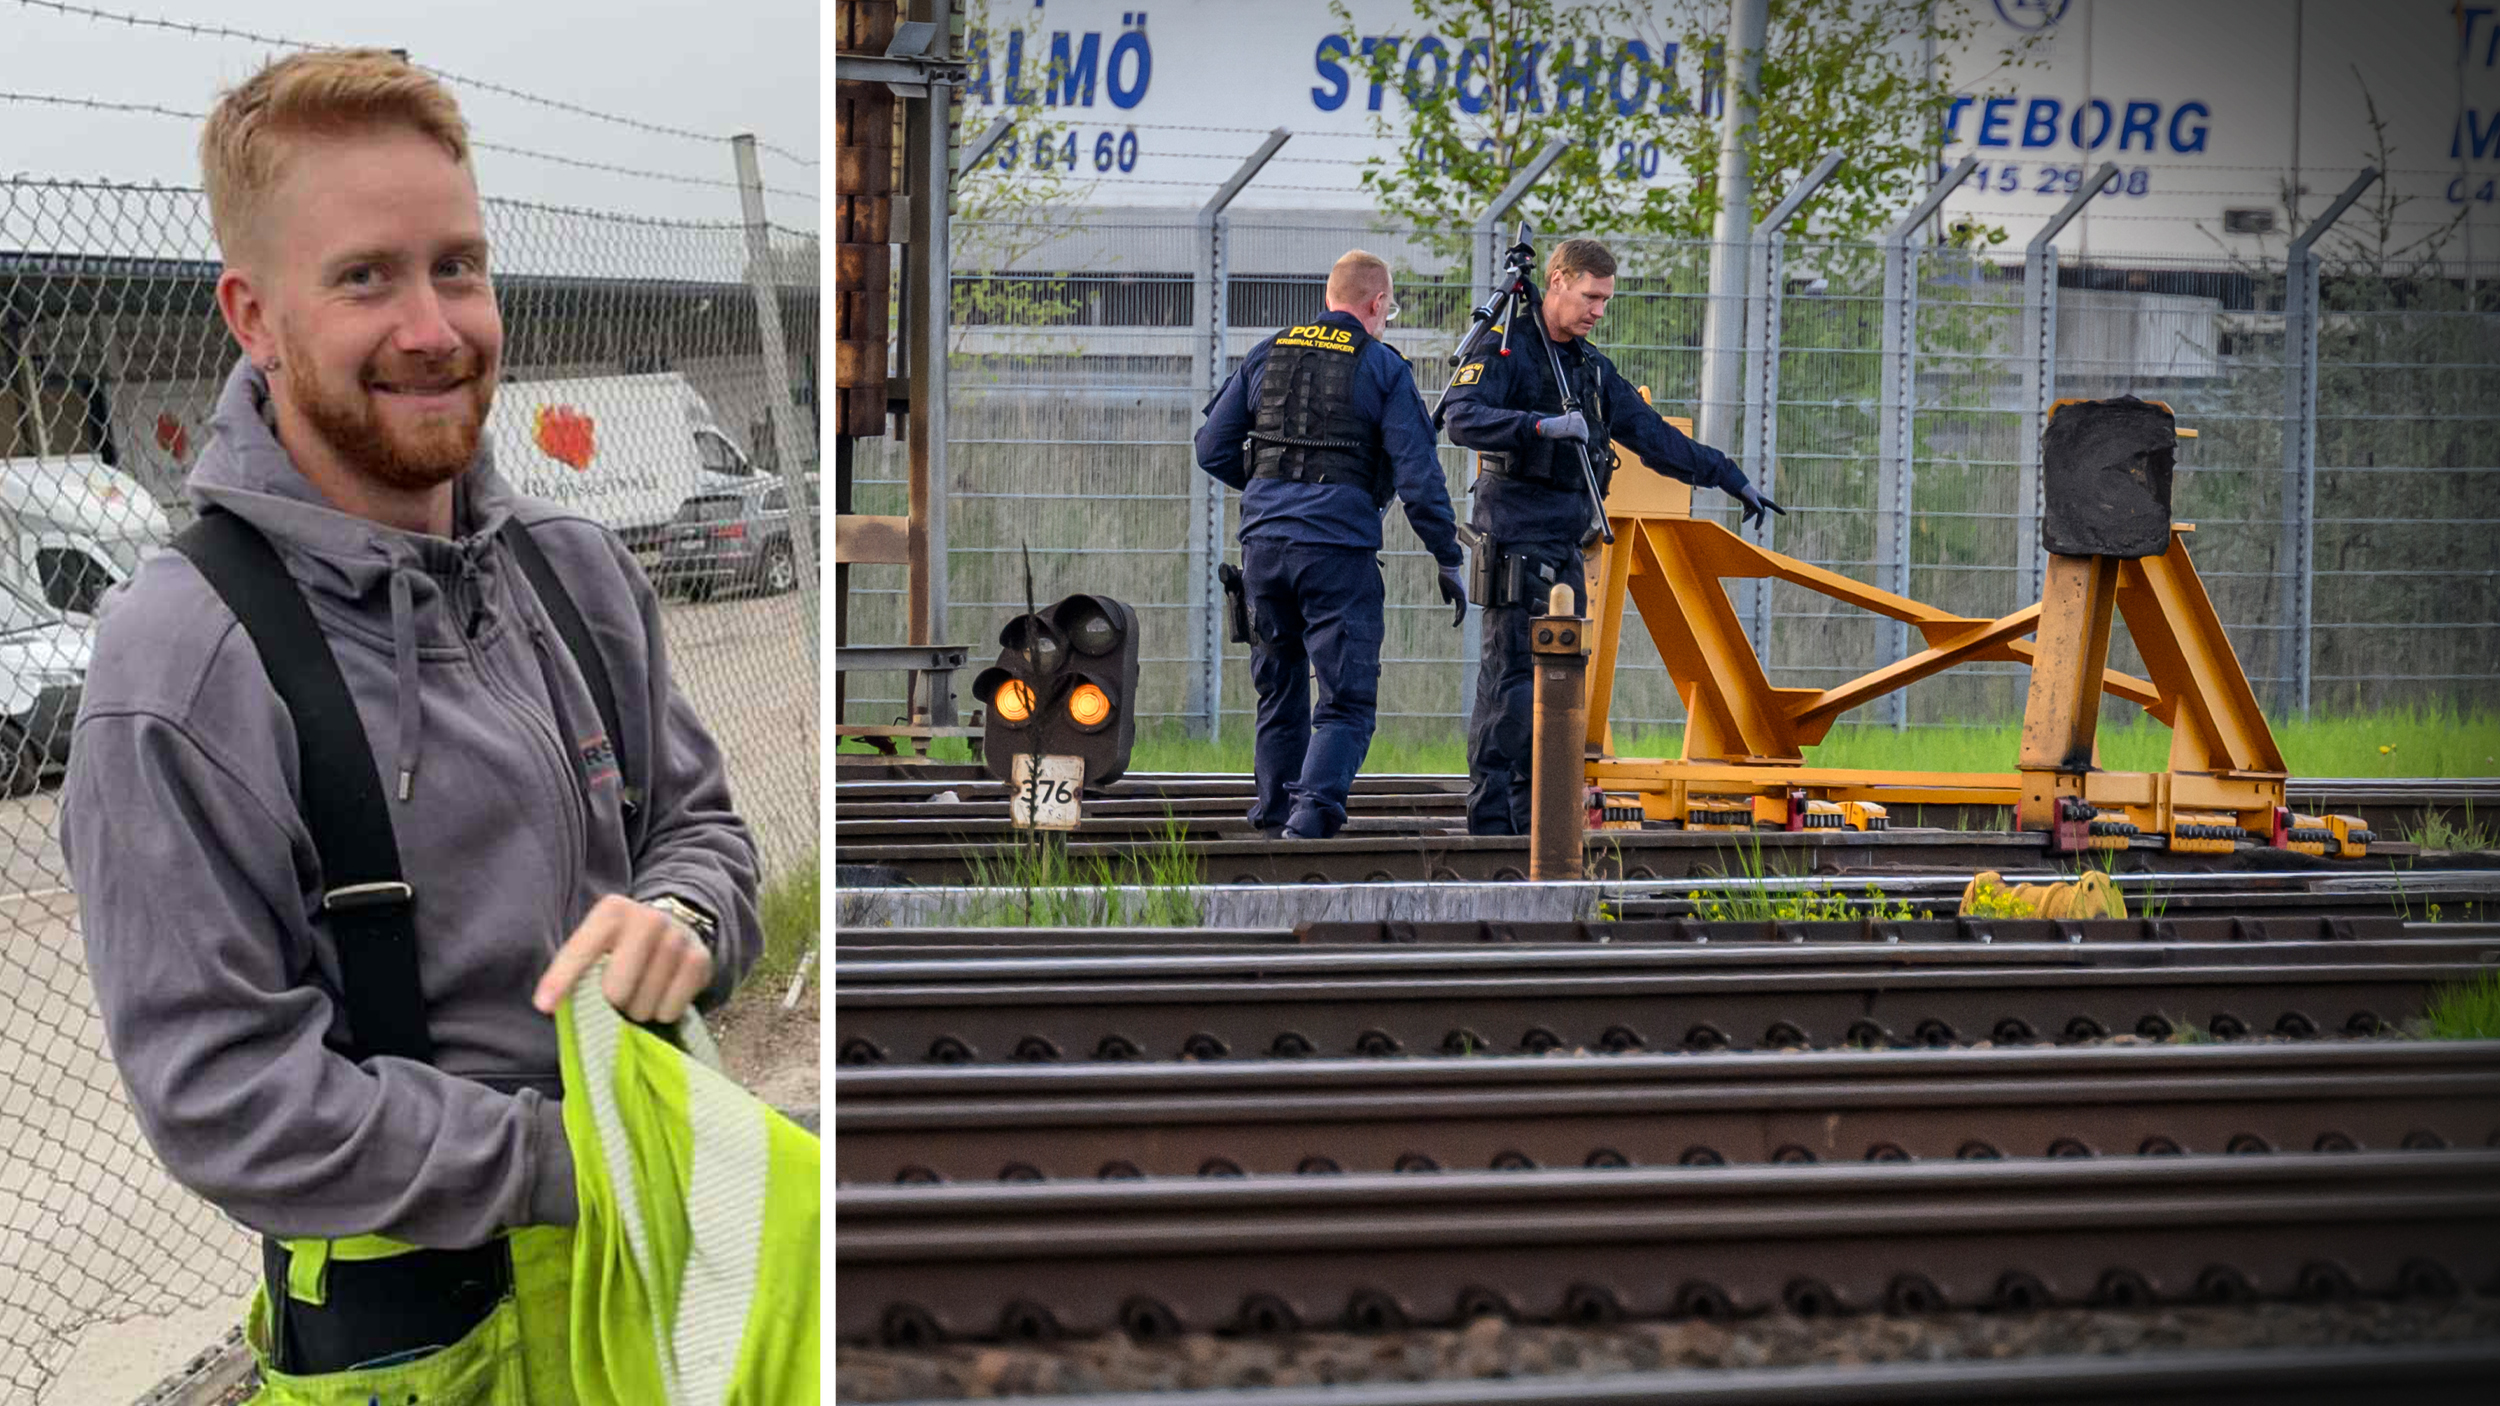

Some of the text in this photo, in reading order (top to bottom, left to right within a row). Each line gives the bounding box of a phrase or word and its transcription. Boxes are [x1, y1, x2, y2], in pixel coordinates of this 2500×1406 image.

[967, 12, 1152, 109] ALMÖ
[1941, 96, 2211, 153] TEBORG
[1036, 131, 1077, 171] 64
[1095, 131, 1138, 172] 60
[2037, 168, 2083, 194] 29
[2101, 169, 2149, 196] 08
[1288, 325, 1352, 343] POLIS
[1021, 779, 1073, 805] 376
